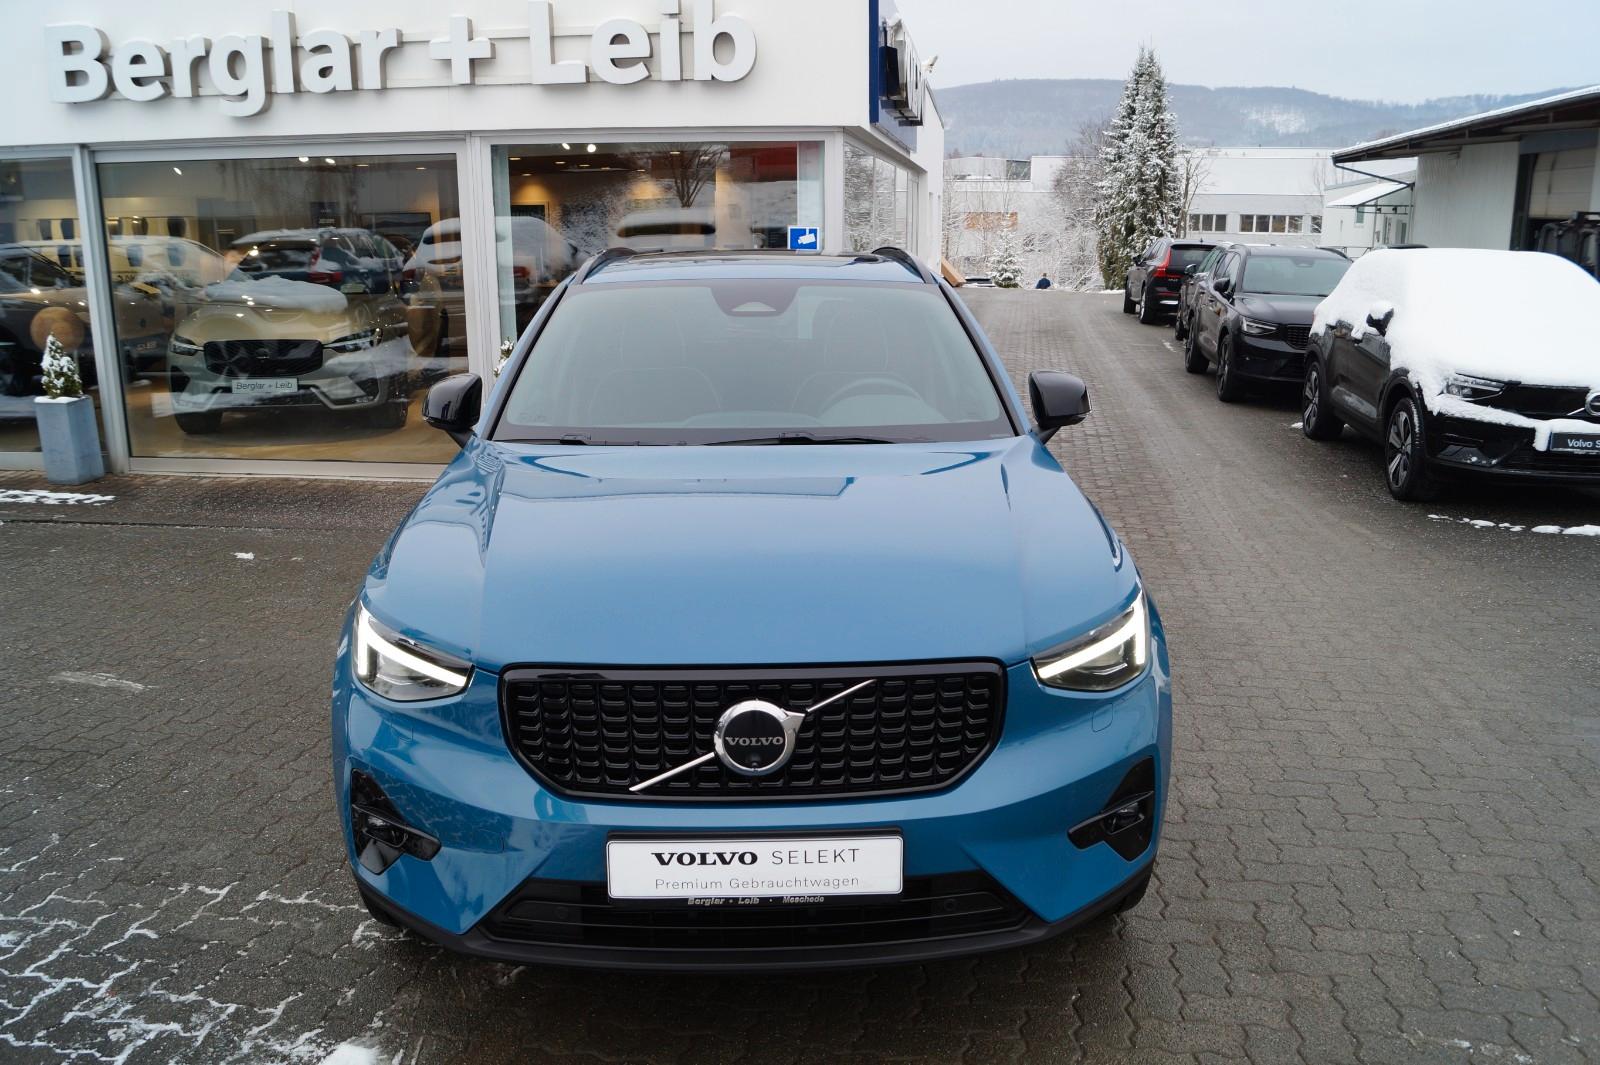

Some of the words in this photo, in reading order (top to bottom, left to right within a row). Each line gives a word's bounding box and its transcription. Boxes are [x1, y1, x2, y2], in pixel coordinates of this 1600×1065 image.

[45, 9, 402, 117] Berglar
[430, 15, 495, 84] +
[528, 0, 757, 84] Leib
[236, 381, 265, 391] Berglar
[275, 381, 293, 389] Leib
[1567, 438, 1593, 448] Volvo
[725, 736, 784, 746] VOLVO
[651, 851, 758, 866] VOLVO
[771, 848, 860, 865] SELEKT
[655, 878, 723, 890] Premium
[729, 876, 859, 890] Gebrauchtwagen
